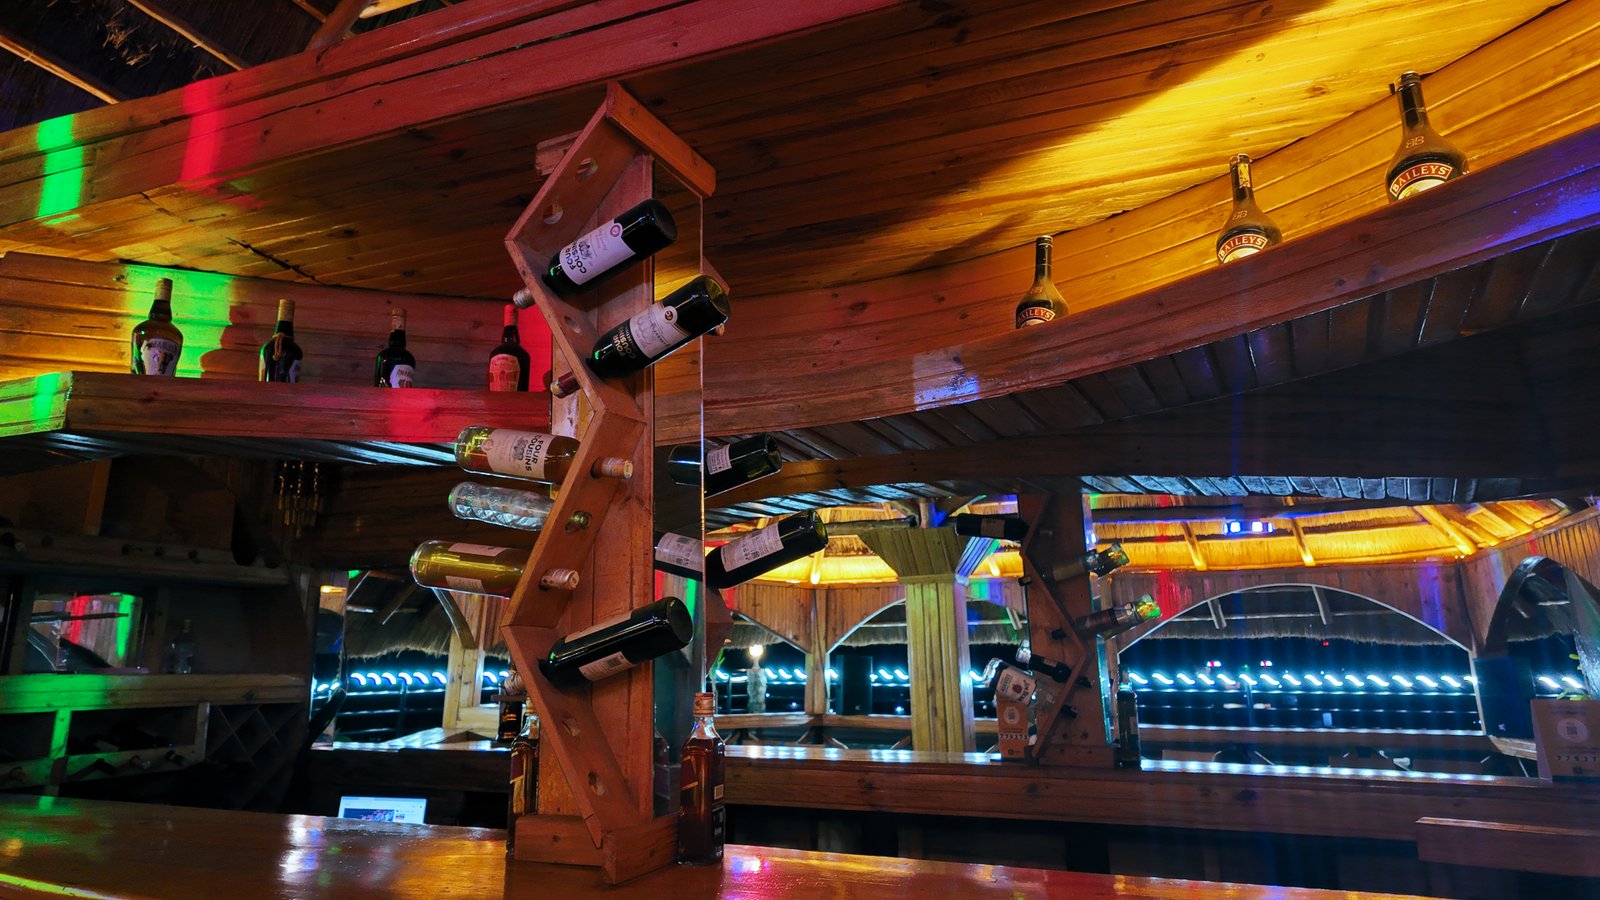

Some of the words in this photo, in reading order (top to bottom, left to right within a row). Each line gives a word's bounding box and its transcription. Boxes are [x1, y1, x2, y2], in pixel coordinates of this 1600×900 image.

[1391, 164, 1451, 193] BAILEYS
[1219, 235, 1265, 258] BAILEYS
[565, 247, 576, 270] FOUR
[1015, 308, 1051, 326] AILEYS
[525, 434, 542, 471] COUSINS
[532, 440, 544, 464] FOUR
